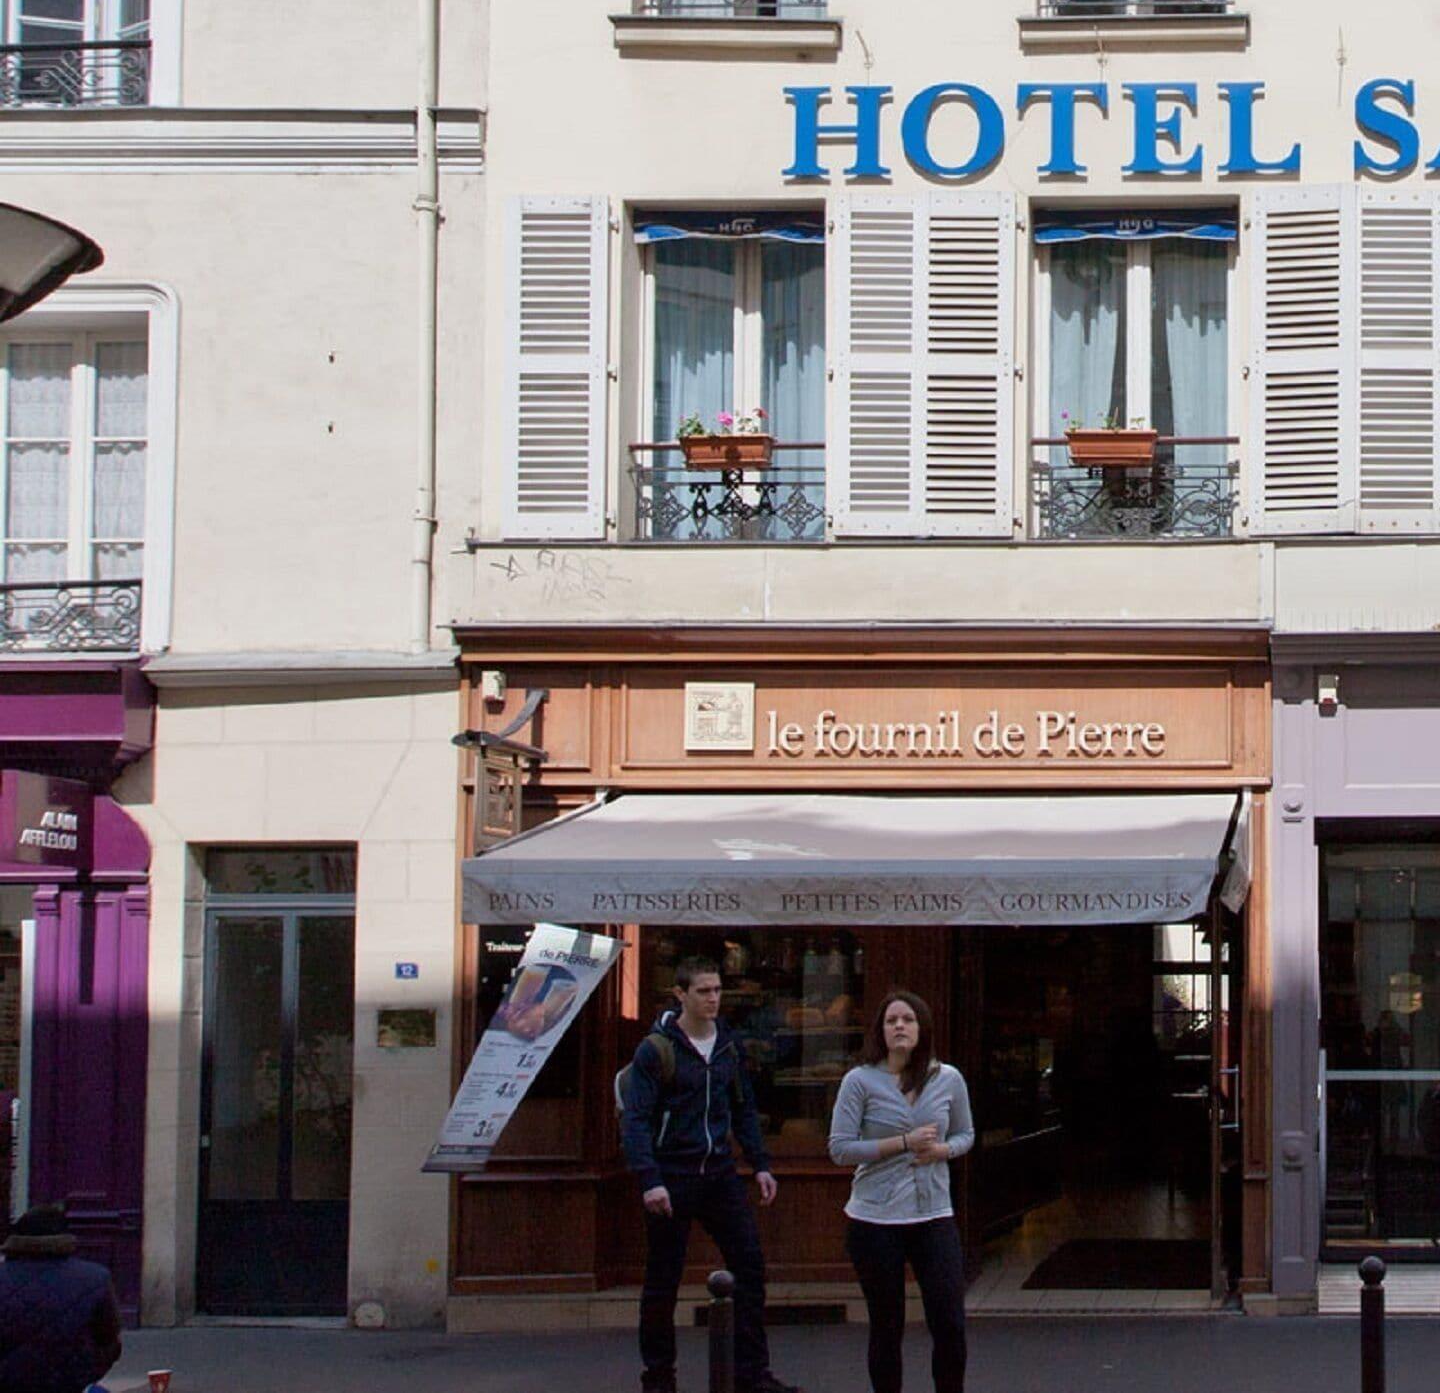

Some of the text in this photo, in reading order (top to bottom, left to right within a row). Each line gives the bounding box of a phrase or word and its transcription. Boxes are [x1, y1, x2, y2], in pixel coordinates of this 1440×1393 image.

[781, 81, 1302, 180] HOTEL
[767, 709, 1166, 757] le fournil de Pierre
[40, 810, 78, 831] ALAIN
[19, 828, 77, 851] AFFLELOU
[488, 891, 1193, 913] PAINS PATISSERIES PETITES FAIMS GOURMANDISES
[400, 964, 414, 976] 12
